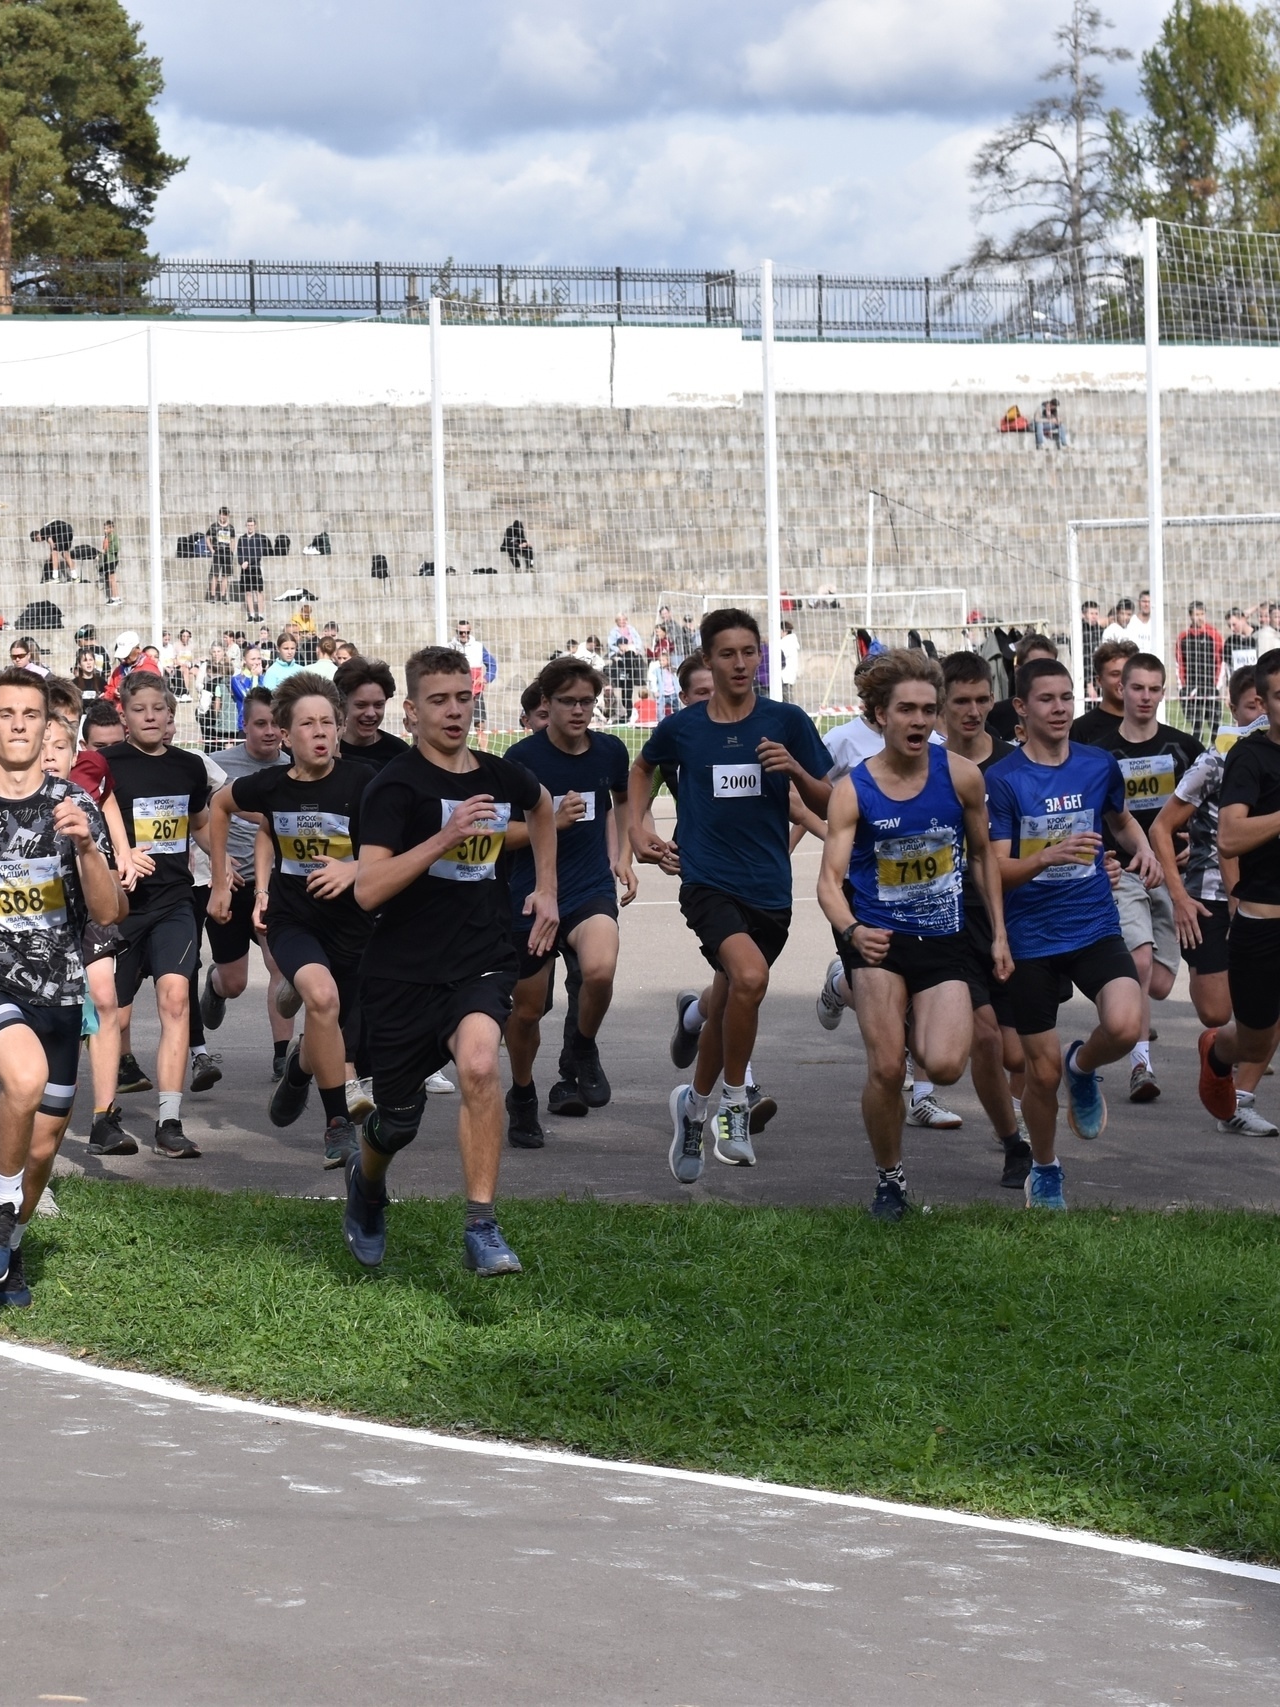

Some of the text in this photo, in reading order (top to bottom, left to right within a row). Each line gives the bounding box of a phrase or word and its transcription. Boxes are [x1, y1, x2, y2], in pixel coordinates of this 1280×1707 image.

[720, 774, 757, 790] 2000
[1126, 776, 1159, 797] 940
[1046, 816, 1066, 824] КРОСС
[1047, 823, 1073, 831] НАЦИИ
[152, 818, 179, 840] 267
[293, 838, 330, 860] 957
[456, 835, 492, 861] 510
[900, 841, 926, 851] НАЦИИ
[0, 869, 30, 879] НАЦИИ
[896, 856, 937, 883] 719
[1046, 871, 1072, 879] ОБЛАСТЬ
